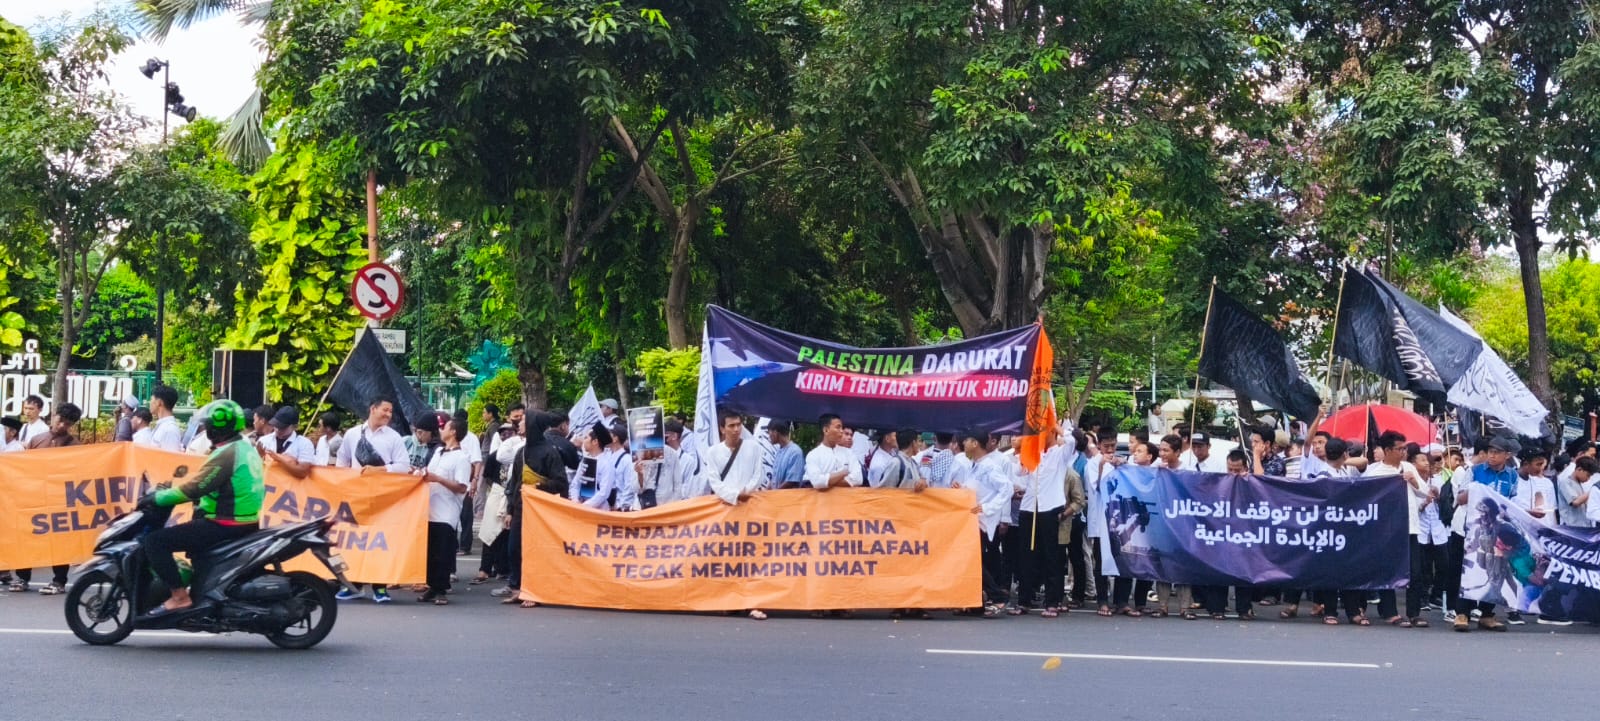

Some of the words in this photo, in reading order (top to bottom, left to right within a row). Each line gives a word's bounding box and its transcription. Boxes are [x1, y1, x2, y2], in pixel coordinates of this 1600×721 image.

[797, 345, 914, 376] PALESTINA
[921, 345, 1027, 374] DARURAT
[795, 371, 845, 392] KIRIM
[849, 376, 918, 397] TENTARA
[923, 380, 980, 397] UNTUK
[982, 379, 1029, 397] JIHAD
[1164, 498, 1231, 519] الاحتلال
[1235, 501, 1293, 526] توقف
[1295, 504, 1319, 526] لن
[1324, 503, 1379, 526] الهدنة
[596, 521, 740, 540] PENJAJAHAN
[746, 521, 769, 537] DI
[775, 519, 897, 537] PALESTINA
[1194, 523, 1270, 548] الجماعية
[1275, 528, 1346, 553] والإبادة
[563, 540, 639, 559] HANYA
[645, 541, 757, 559] BERAKHIR
[762, 541, 812, 557] JIKA
[818, 540, 929, 555] KHILAFAH
[1539, 536, 1600, 566] KHILAFA
[612, 563, 684, 579] TEGAK
[691, 562, 807, 578] MEMIMPIN
[815, 560, 878, 576] UMAT
